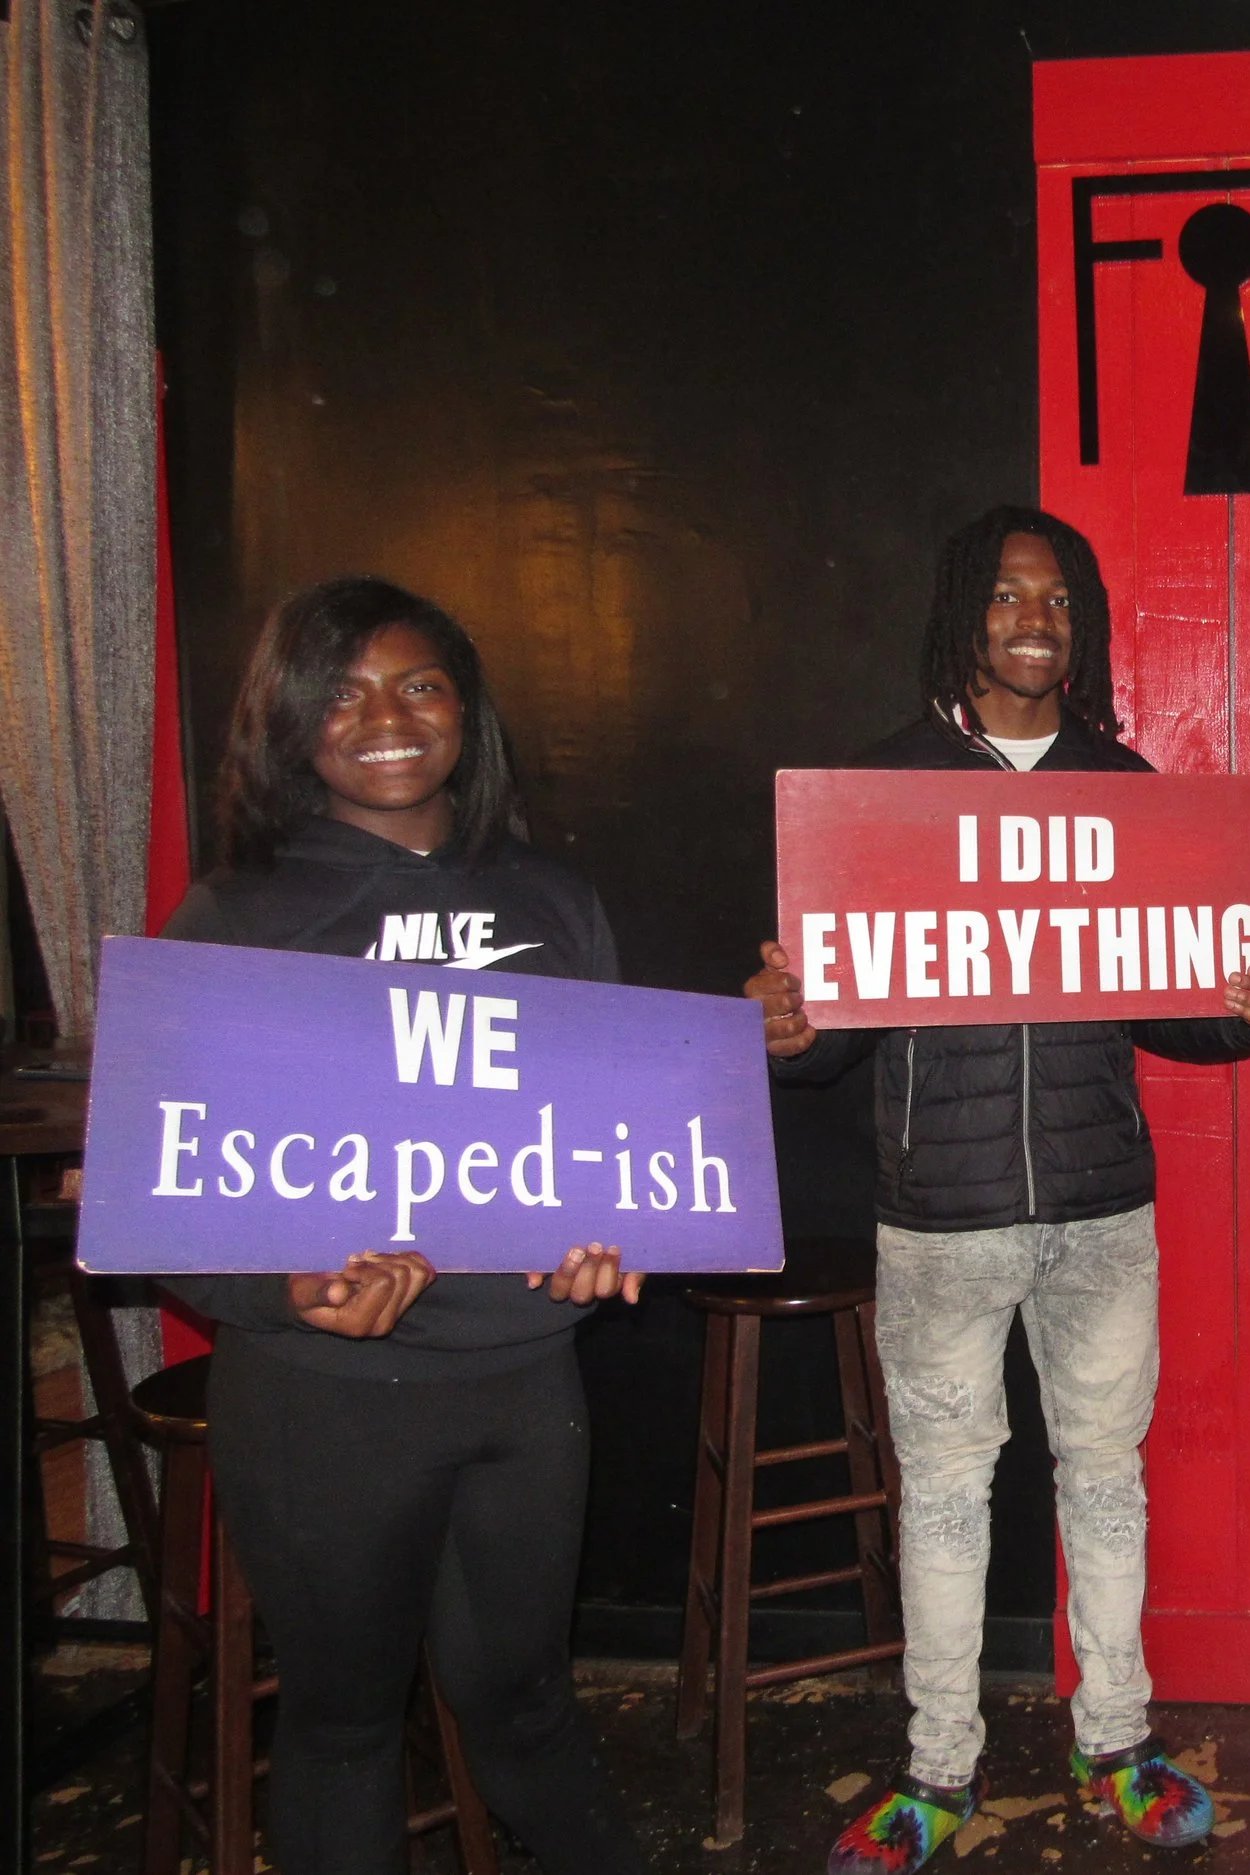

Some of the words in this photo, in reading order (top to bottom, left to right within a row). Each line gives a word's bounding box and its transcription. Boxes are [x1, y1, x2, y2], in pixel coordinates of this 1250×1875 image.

[958, 814, 978, 883] I
[999, 815, 1115, 883] DID
[380, 912, 496, 961] NIKE
[388, 987, 520, 1091] WE
[152, 1101, 738, 1242] Escaped-ish
